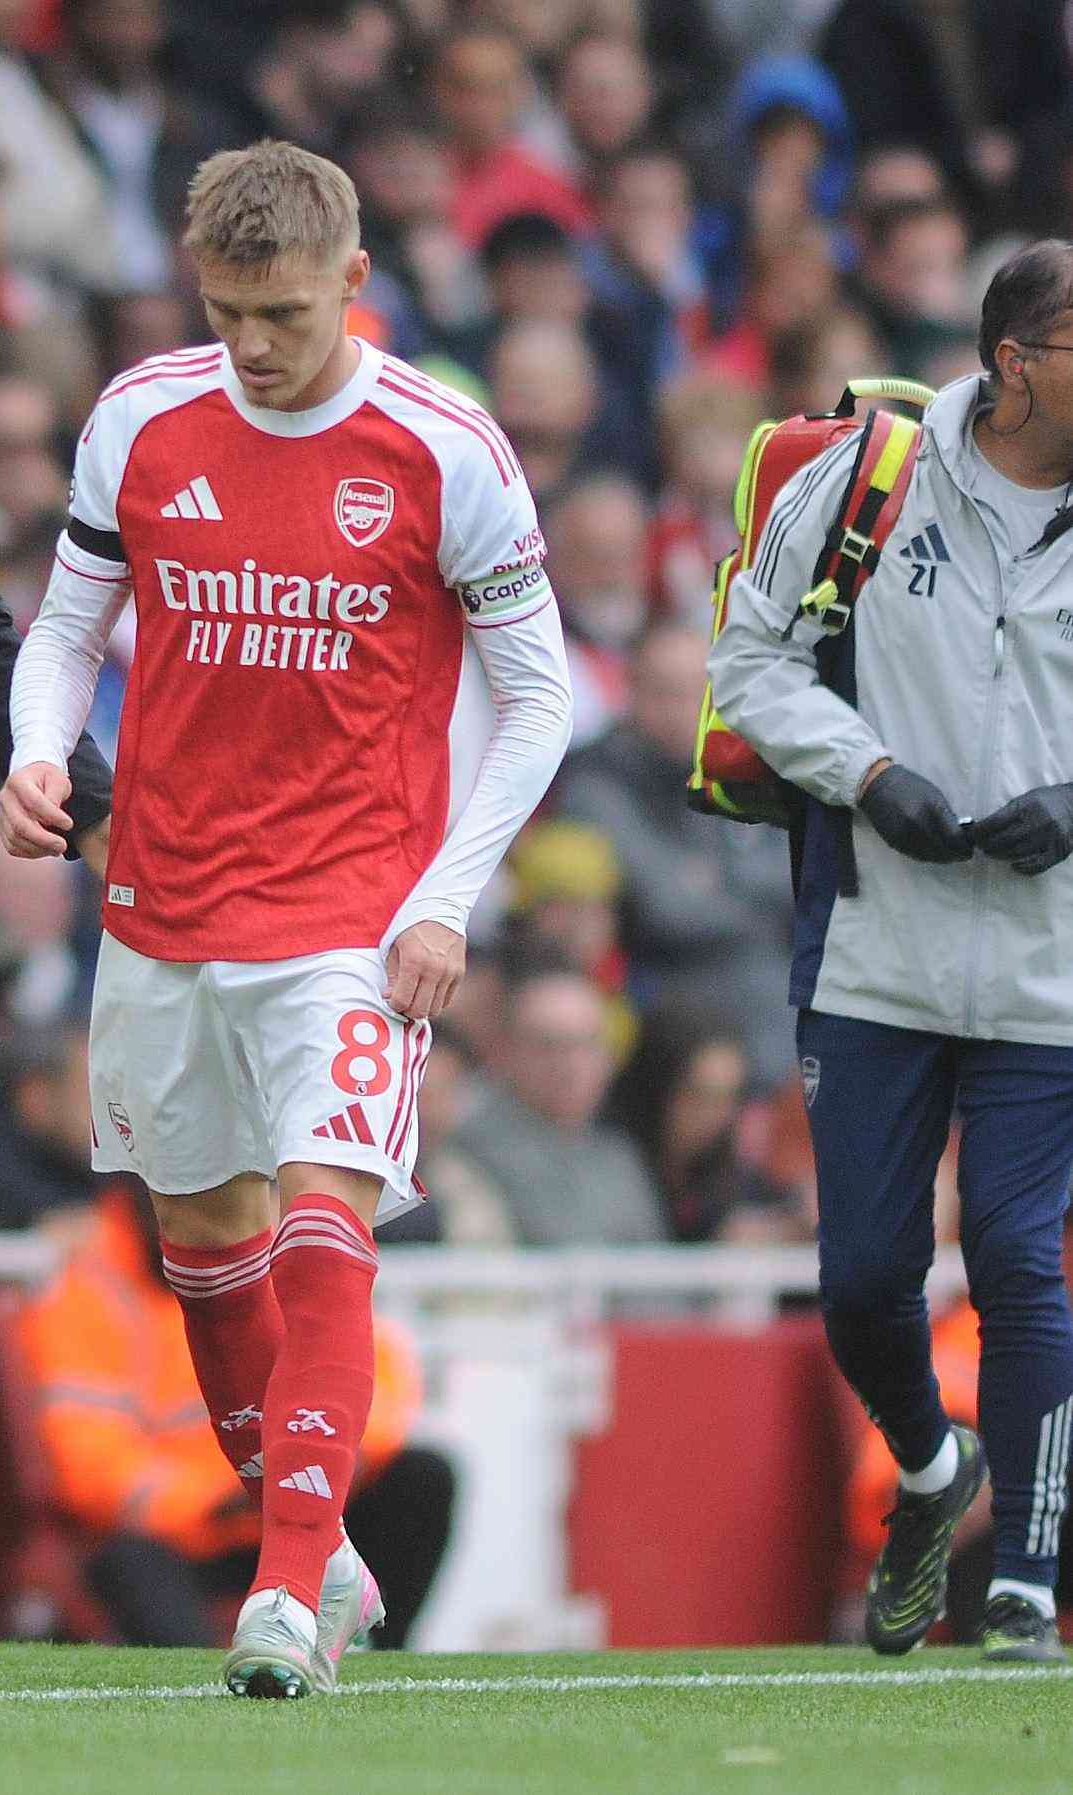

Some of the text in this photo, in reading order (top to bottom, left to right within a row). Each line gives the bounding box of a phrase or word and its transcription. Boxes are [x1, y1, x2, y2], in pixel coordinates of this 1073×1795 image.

[513, 528, 543, 555] VIS
[154, 559, 392, 624] Emirates
[908, 564, 938, 598] 21
[186, 620, 354, 672] FLY BETTER
[331, 1010, 392, 1096] 8
